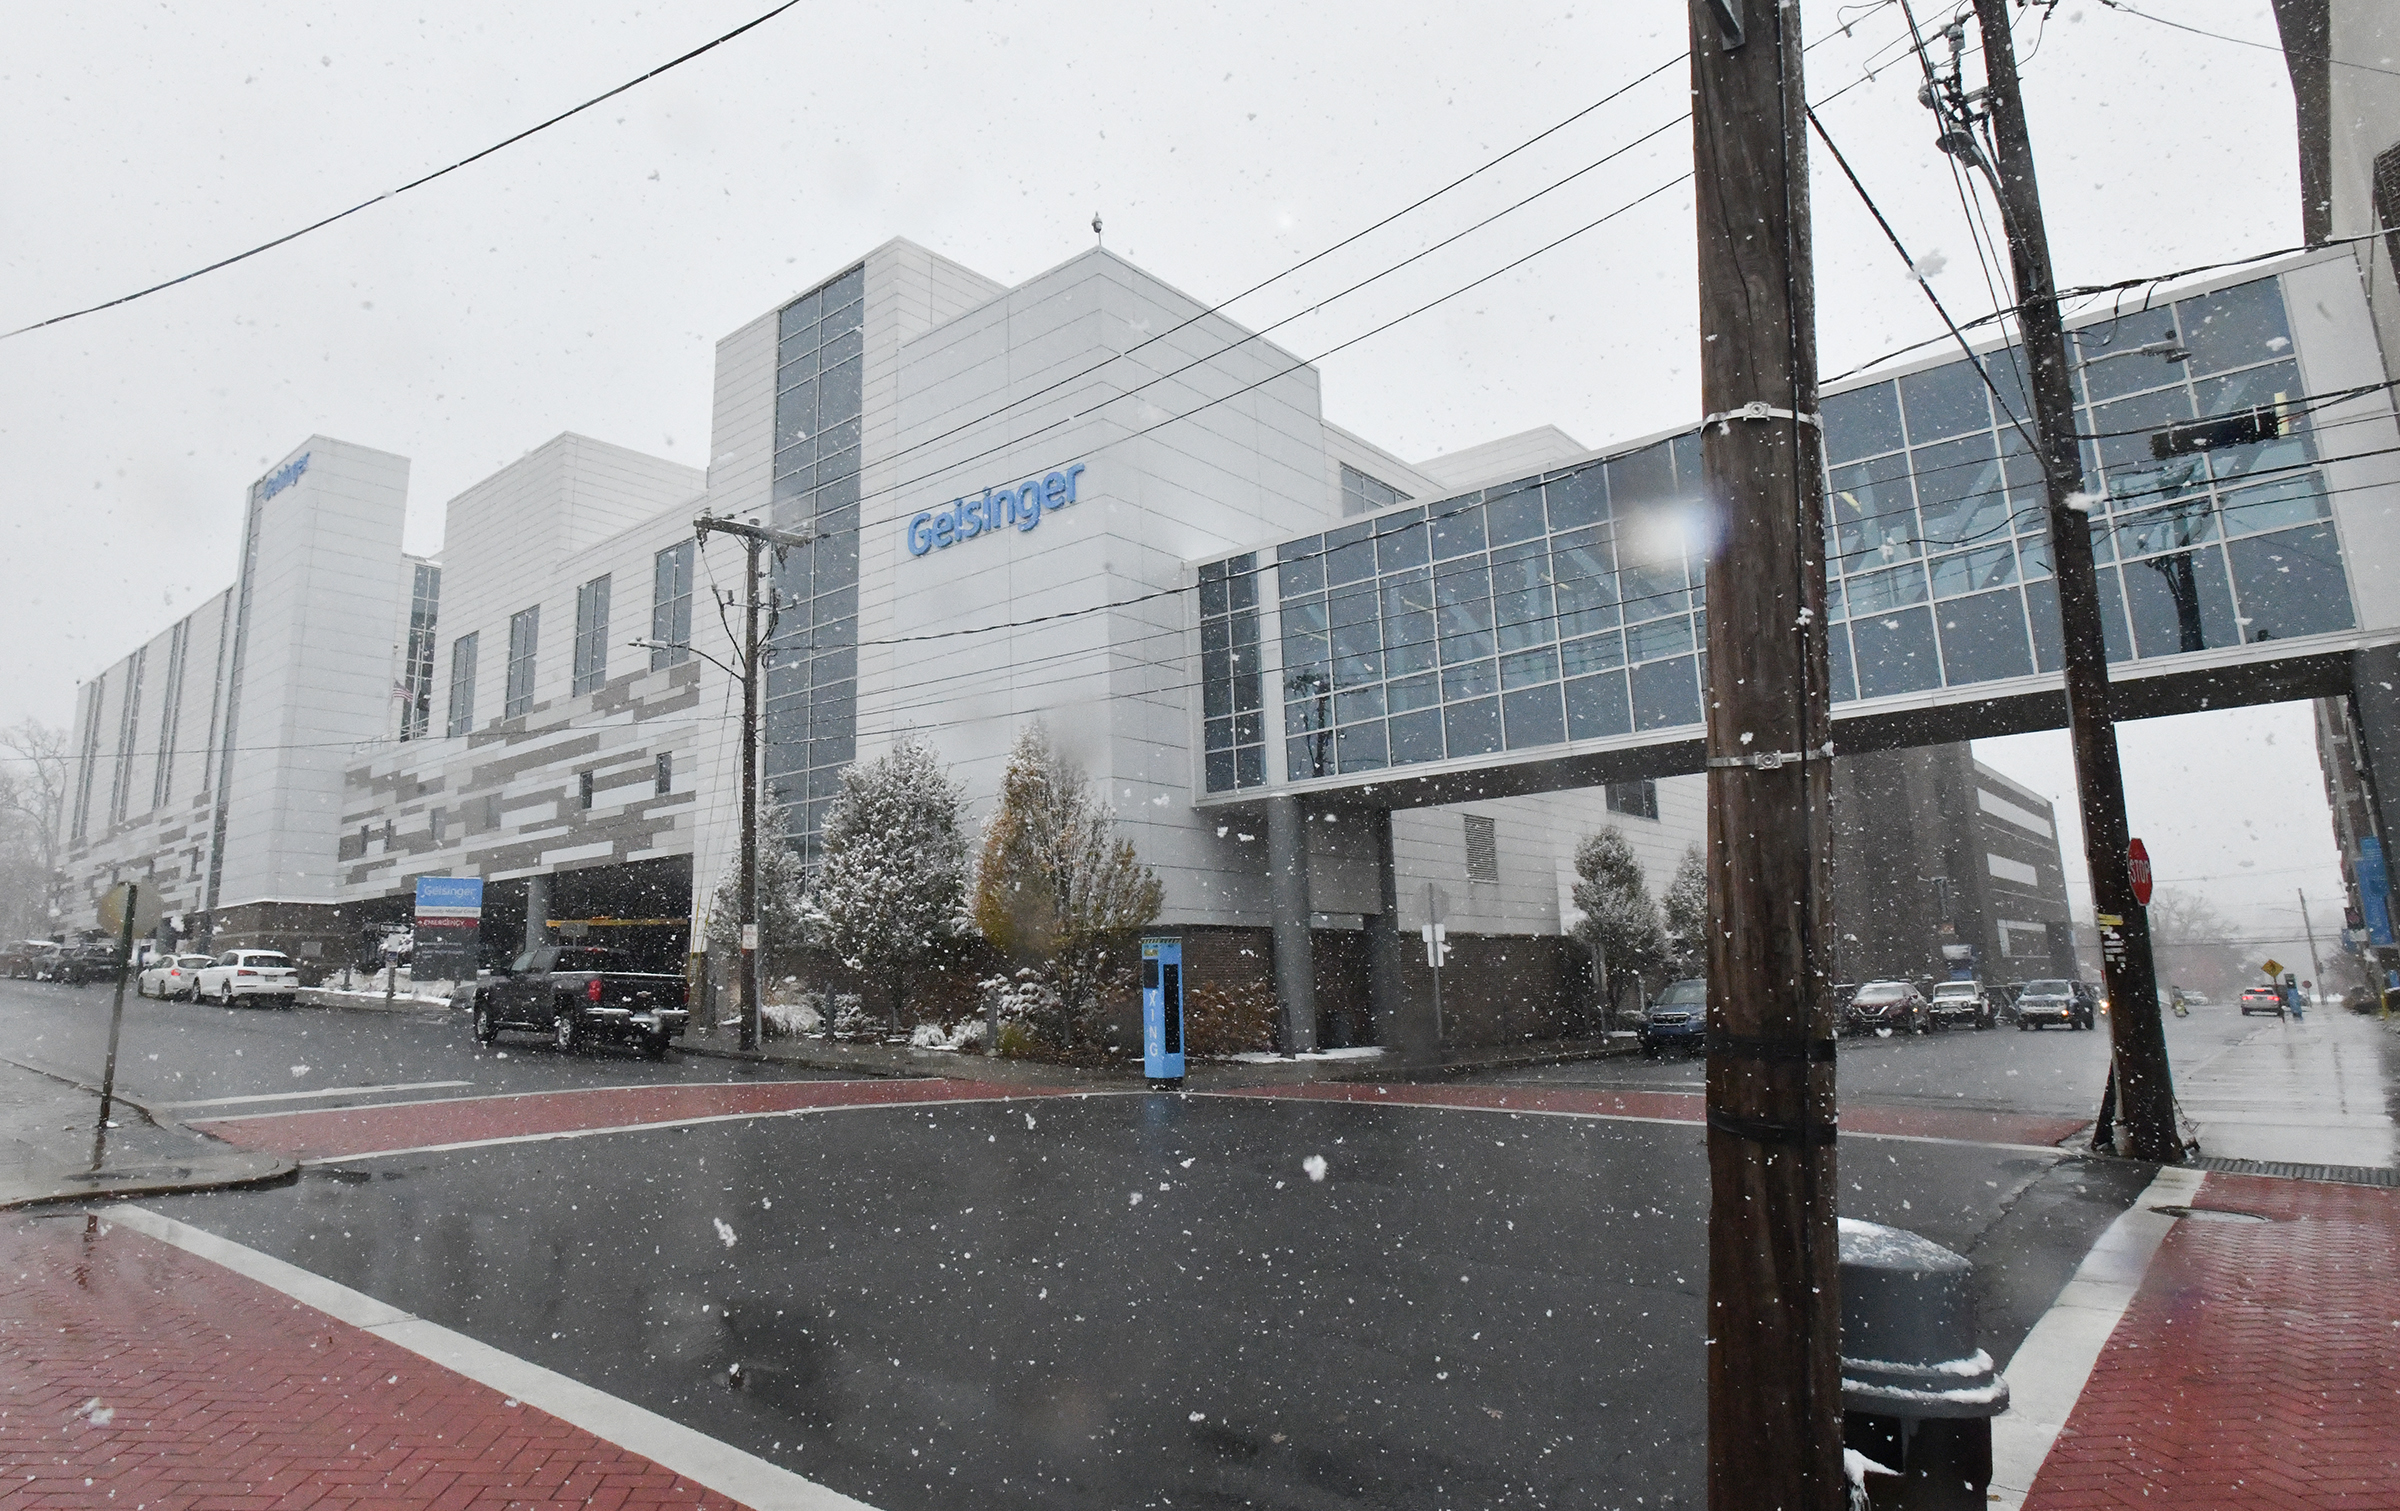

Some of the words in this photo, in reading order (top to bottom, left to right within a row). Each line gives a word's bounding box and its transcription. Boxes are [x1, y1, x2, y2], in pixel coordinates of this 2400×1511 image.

[907, 462, 1085, 557] Geisinger
[2129, 859, 2150, 884] STOP
[424, 885, 477, 898] Geisinger
[423, 919, 465, 927] EMERGENCY
